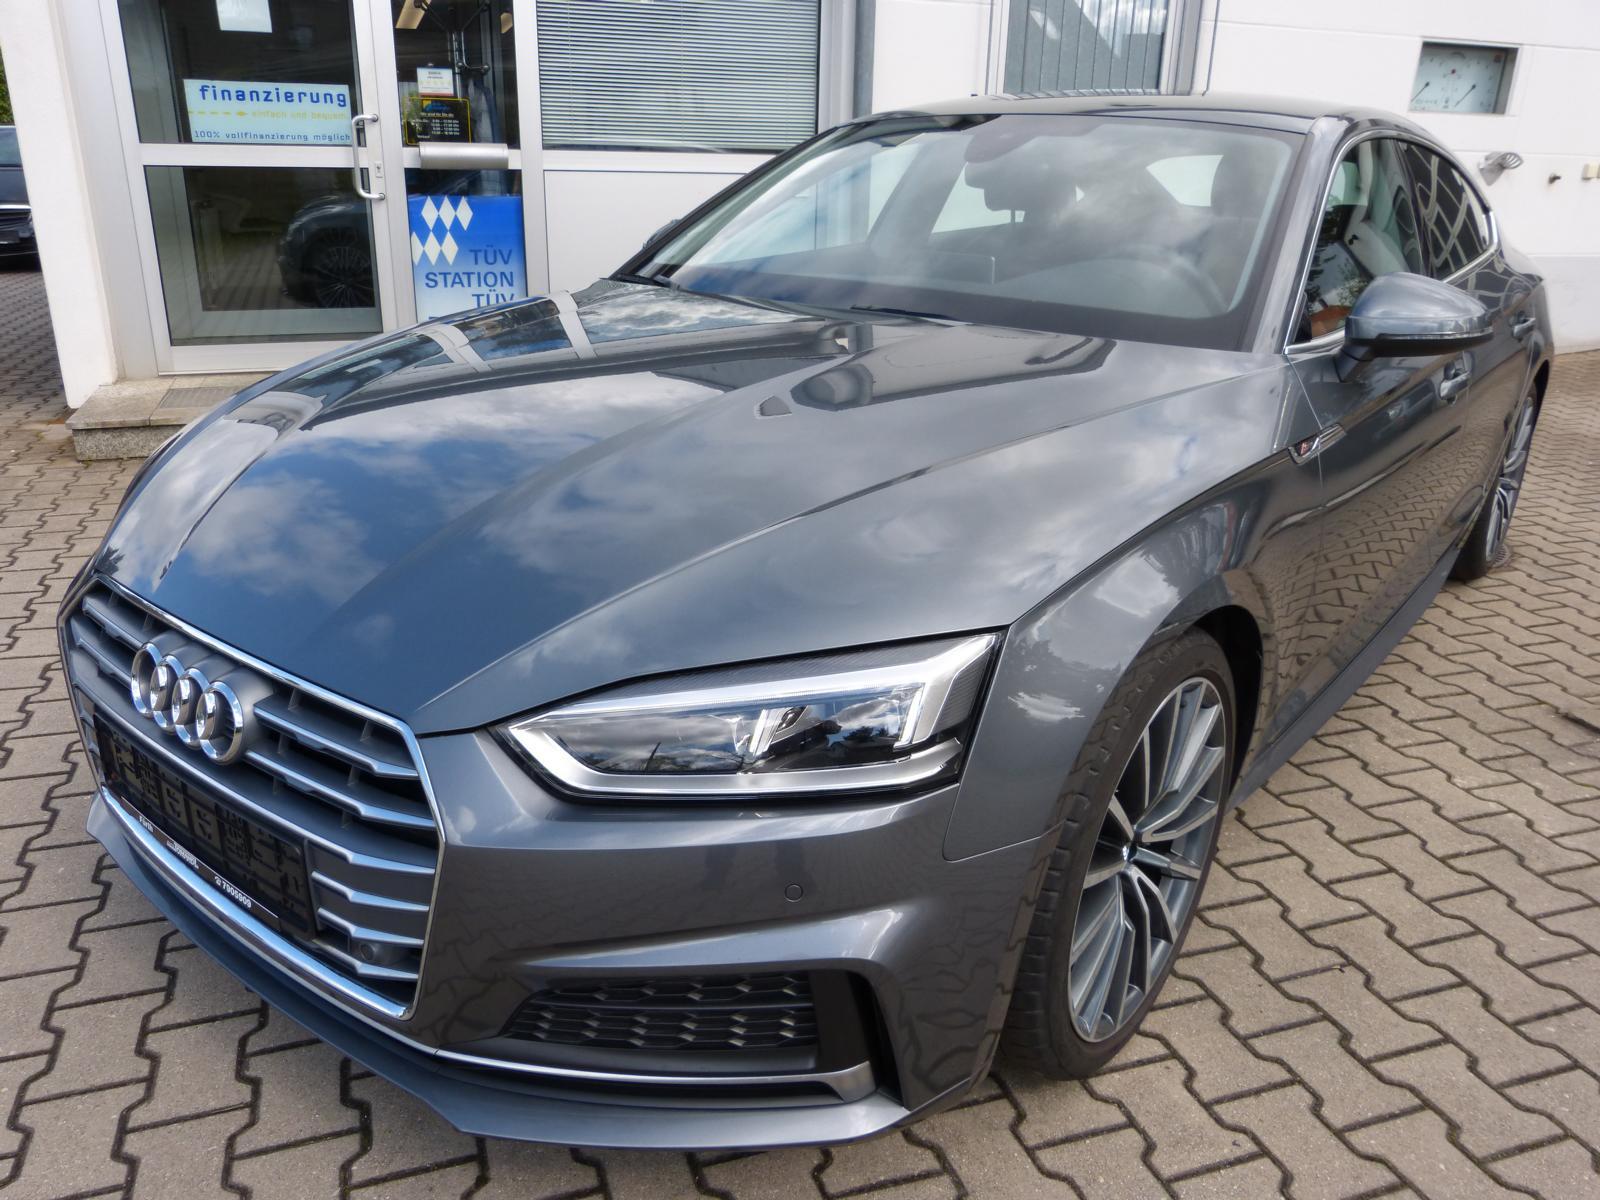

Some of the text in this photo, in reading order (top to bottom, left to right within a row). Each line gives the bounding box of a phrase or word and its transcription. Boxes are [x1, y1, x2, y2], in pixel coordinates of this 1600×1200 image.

[200, 84, 347, 107] finanzierung
[194, 130, 351, 142] 100% vollfinanzierung möglich
[469, 244, 513, 266] TÜV
[425, 271, 514, 289] STATION
[139, 815, 154, 833] Fürth
